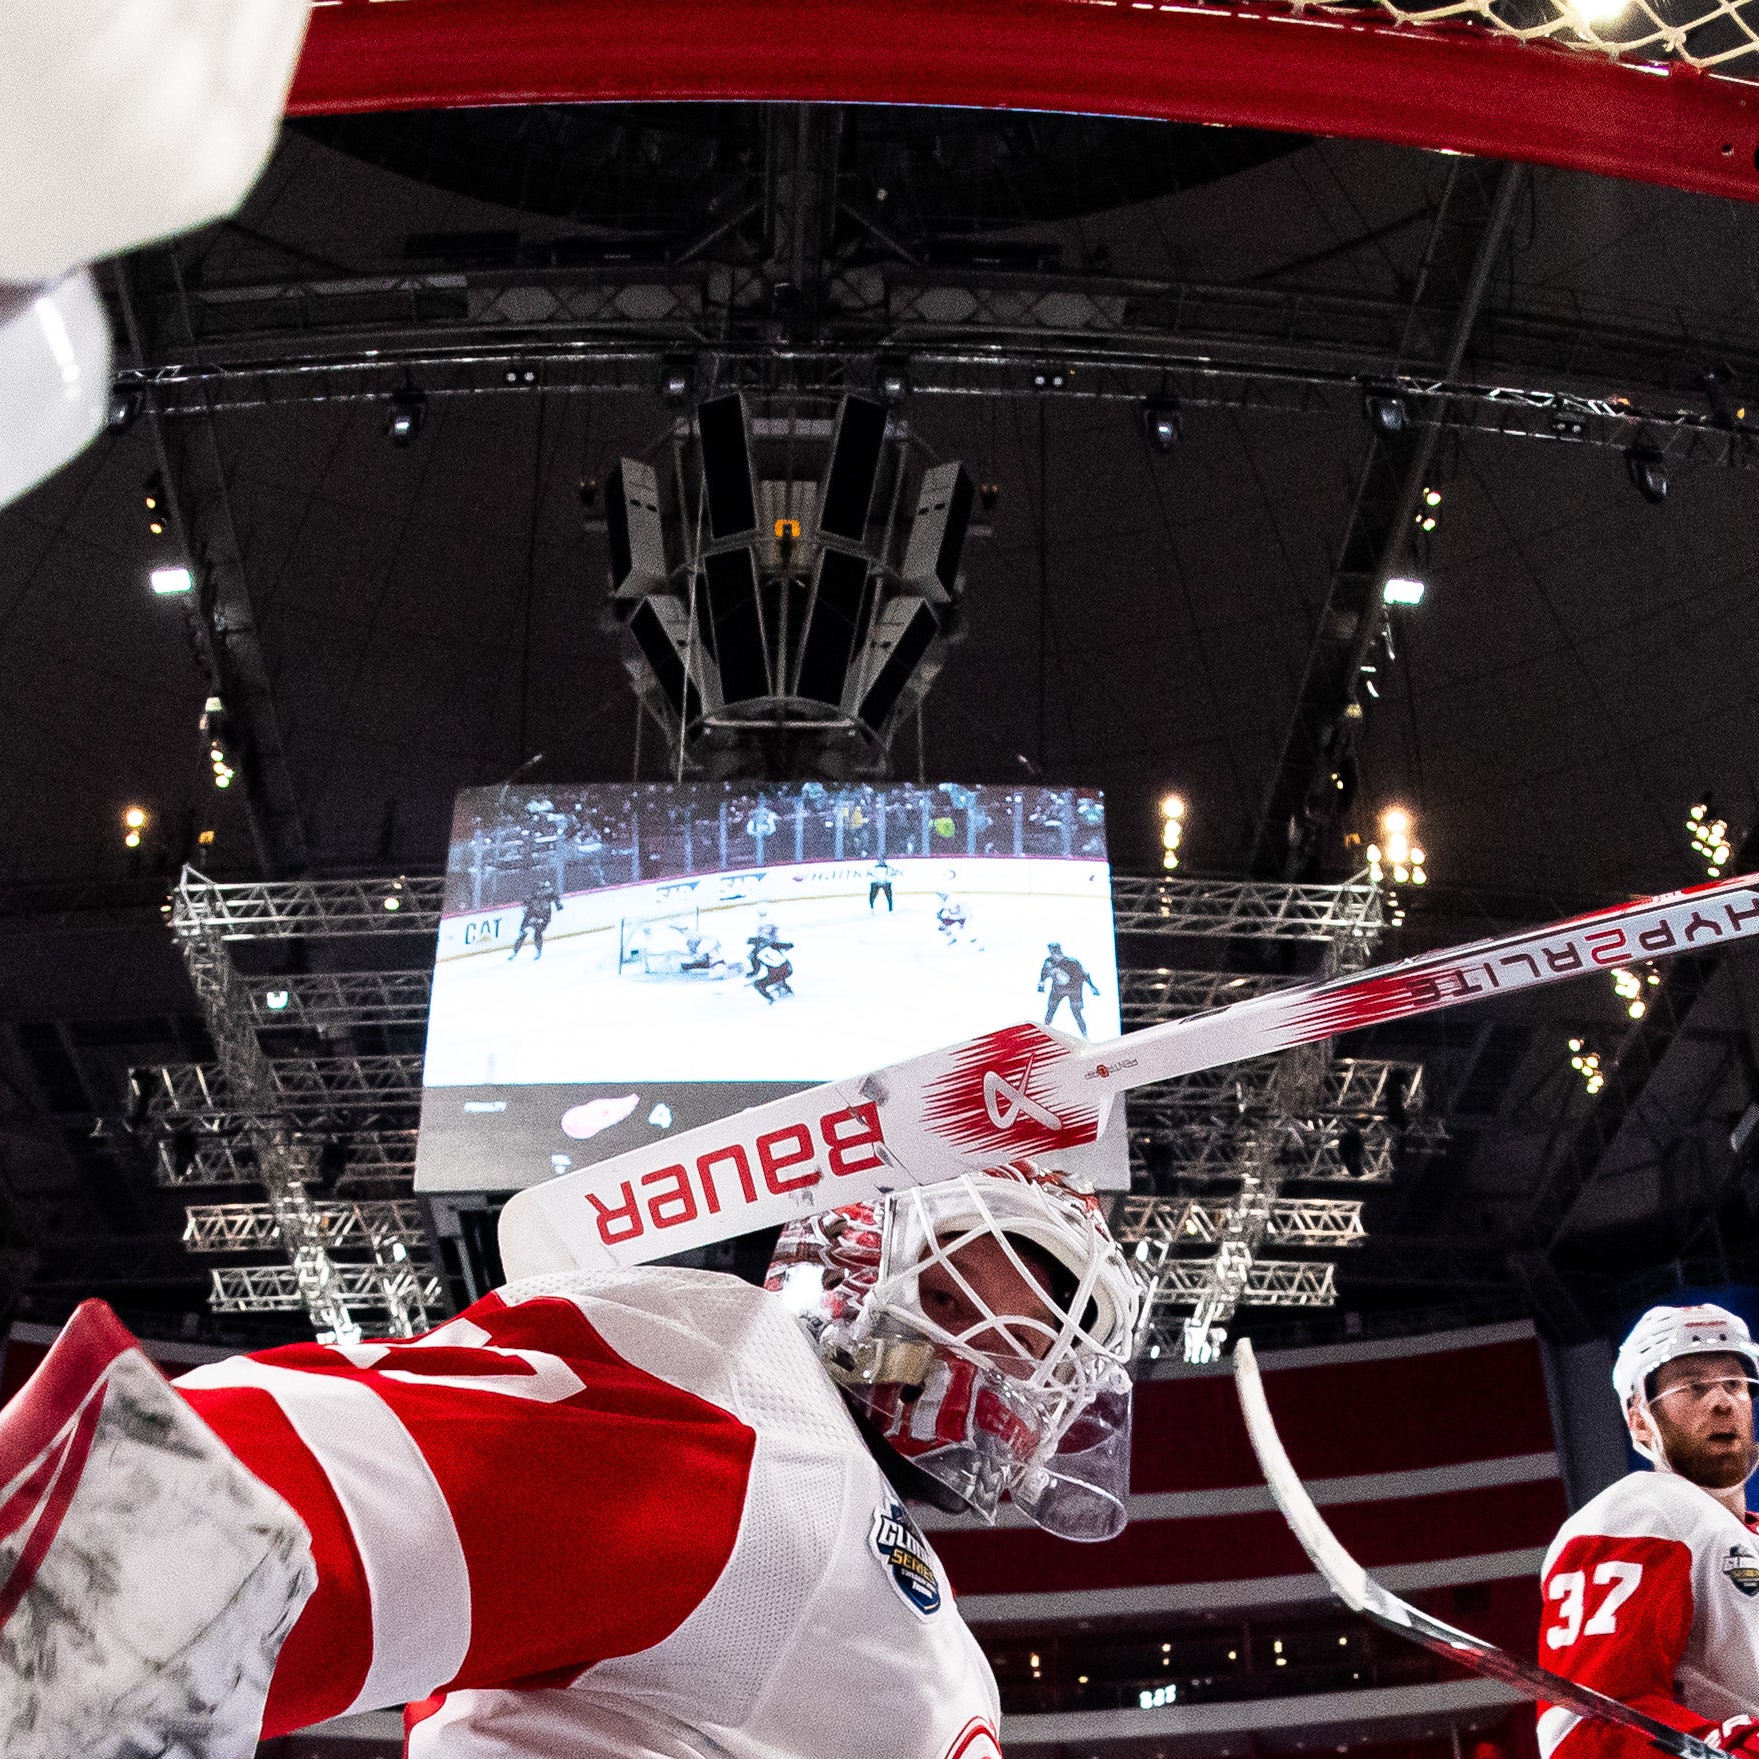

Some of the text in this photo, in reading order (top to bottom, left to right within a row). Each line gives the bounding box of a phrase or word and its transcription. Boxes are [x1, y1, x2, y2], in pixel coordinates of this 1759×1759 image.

[464, 917, 502, 945] CAT
[649, 1102, 672, 1129] 4
[584, 1101, 886, 1246] BAUER
[1546, 1560, 1643, 1651] 37
